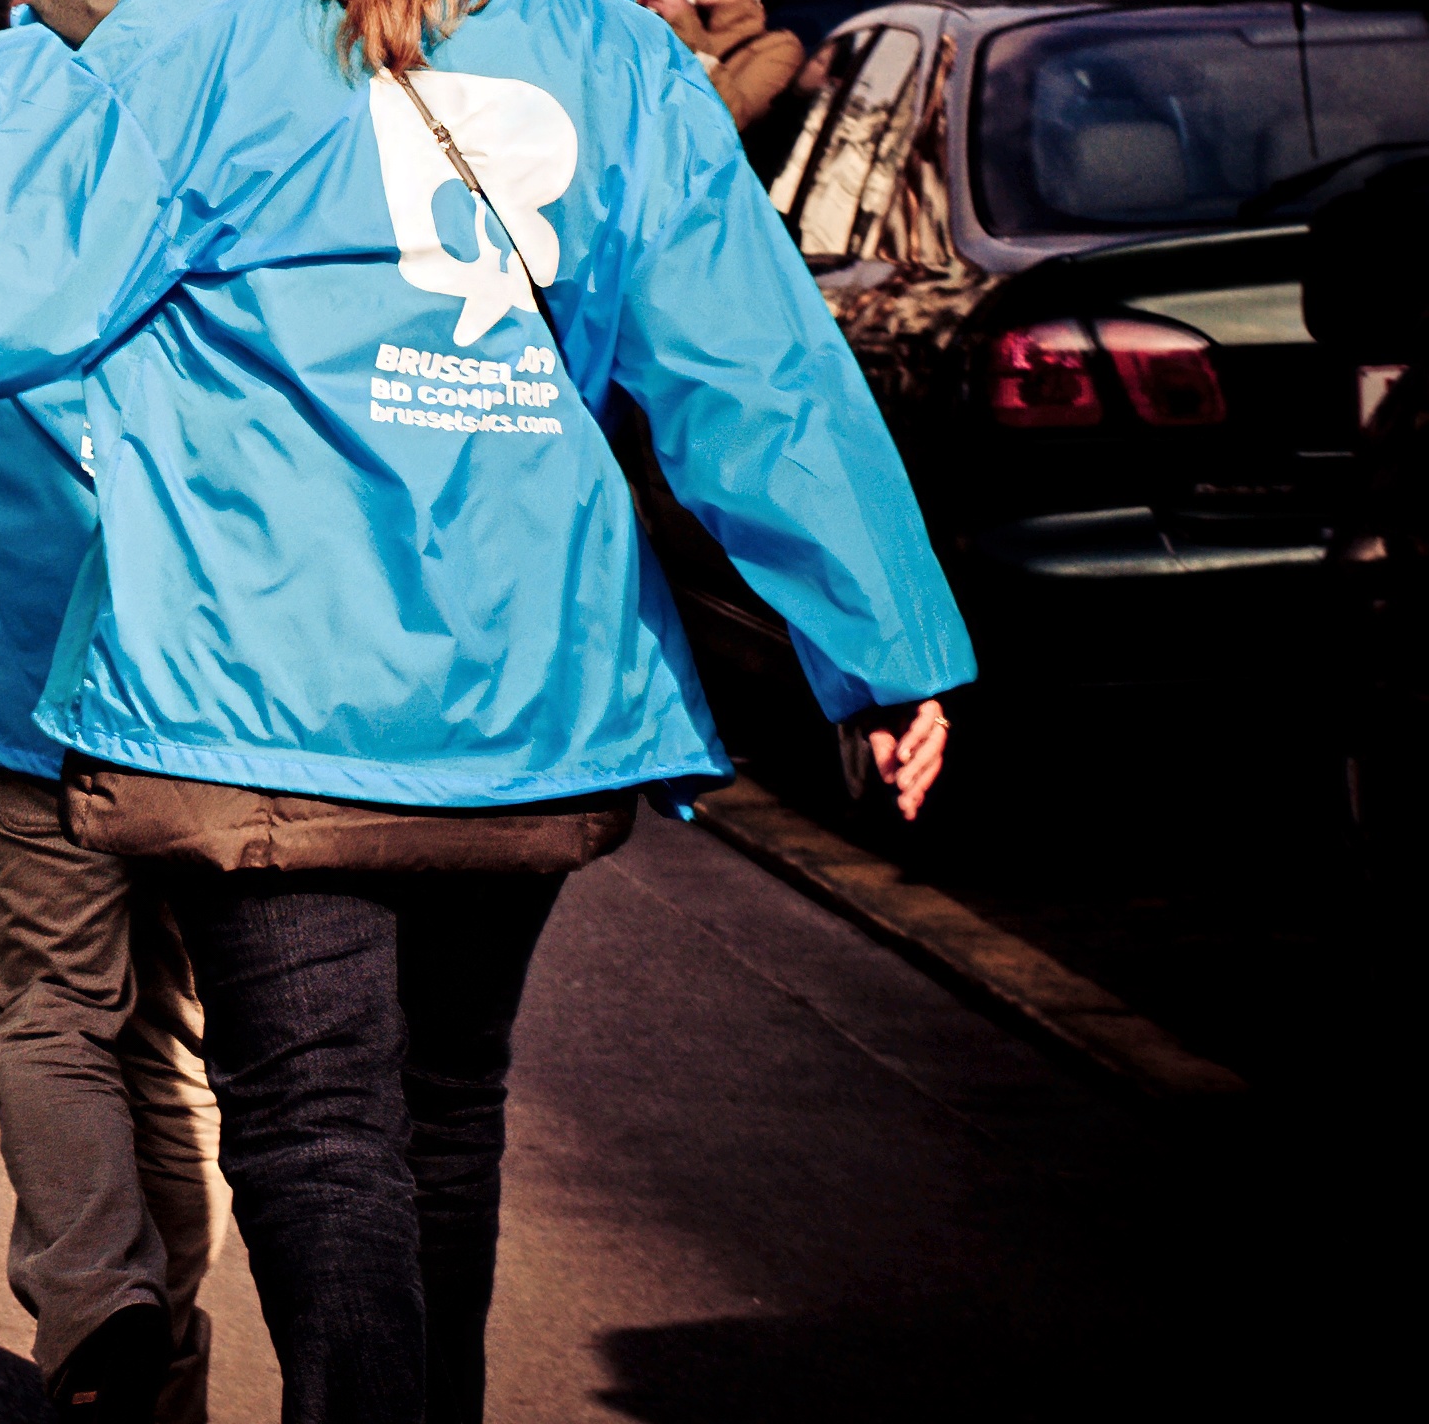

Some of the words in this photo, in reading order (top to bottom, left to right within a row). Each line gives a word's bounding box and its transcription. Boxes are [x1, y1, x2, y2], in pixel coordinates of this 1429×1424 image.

[375, 343, 511, 385] BRUSSEL
[370, 376, 412, 402] BD
[505, 380, 559, 408] TRIP
